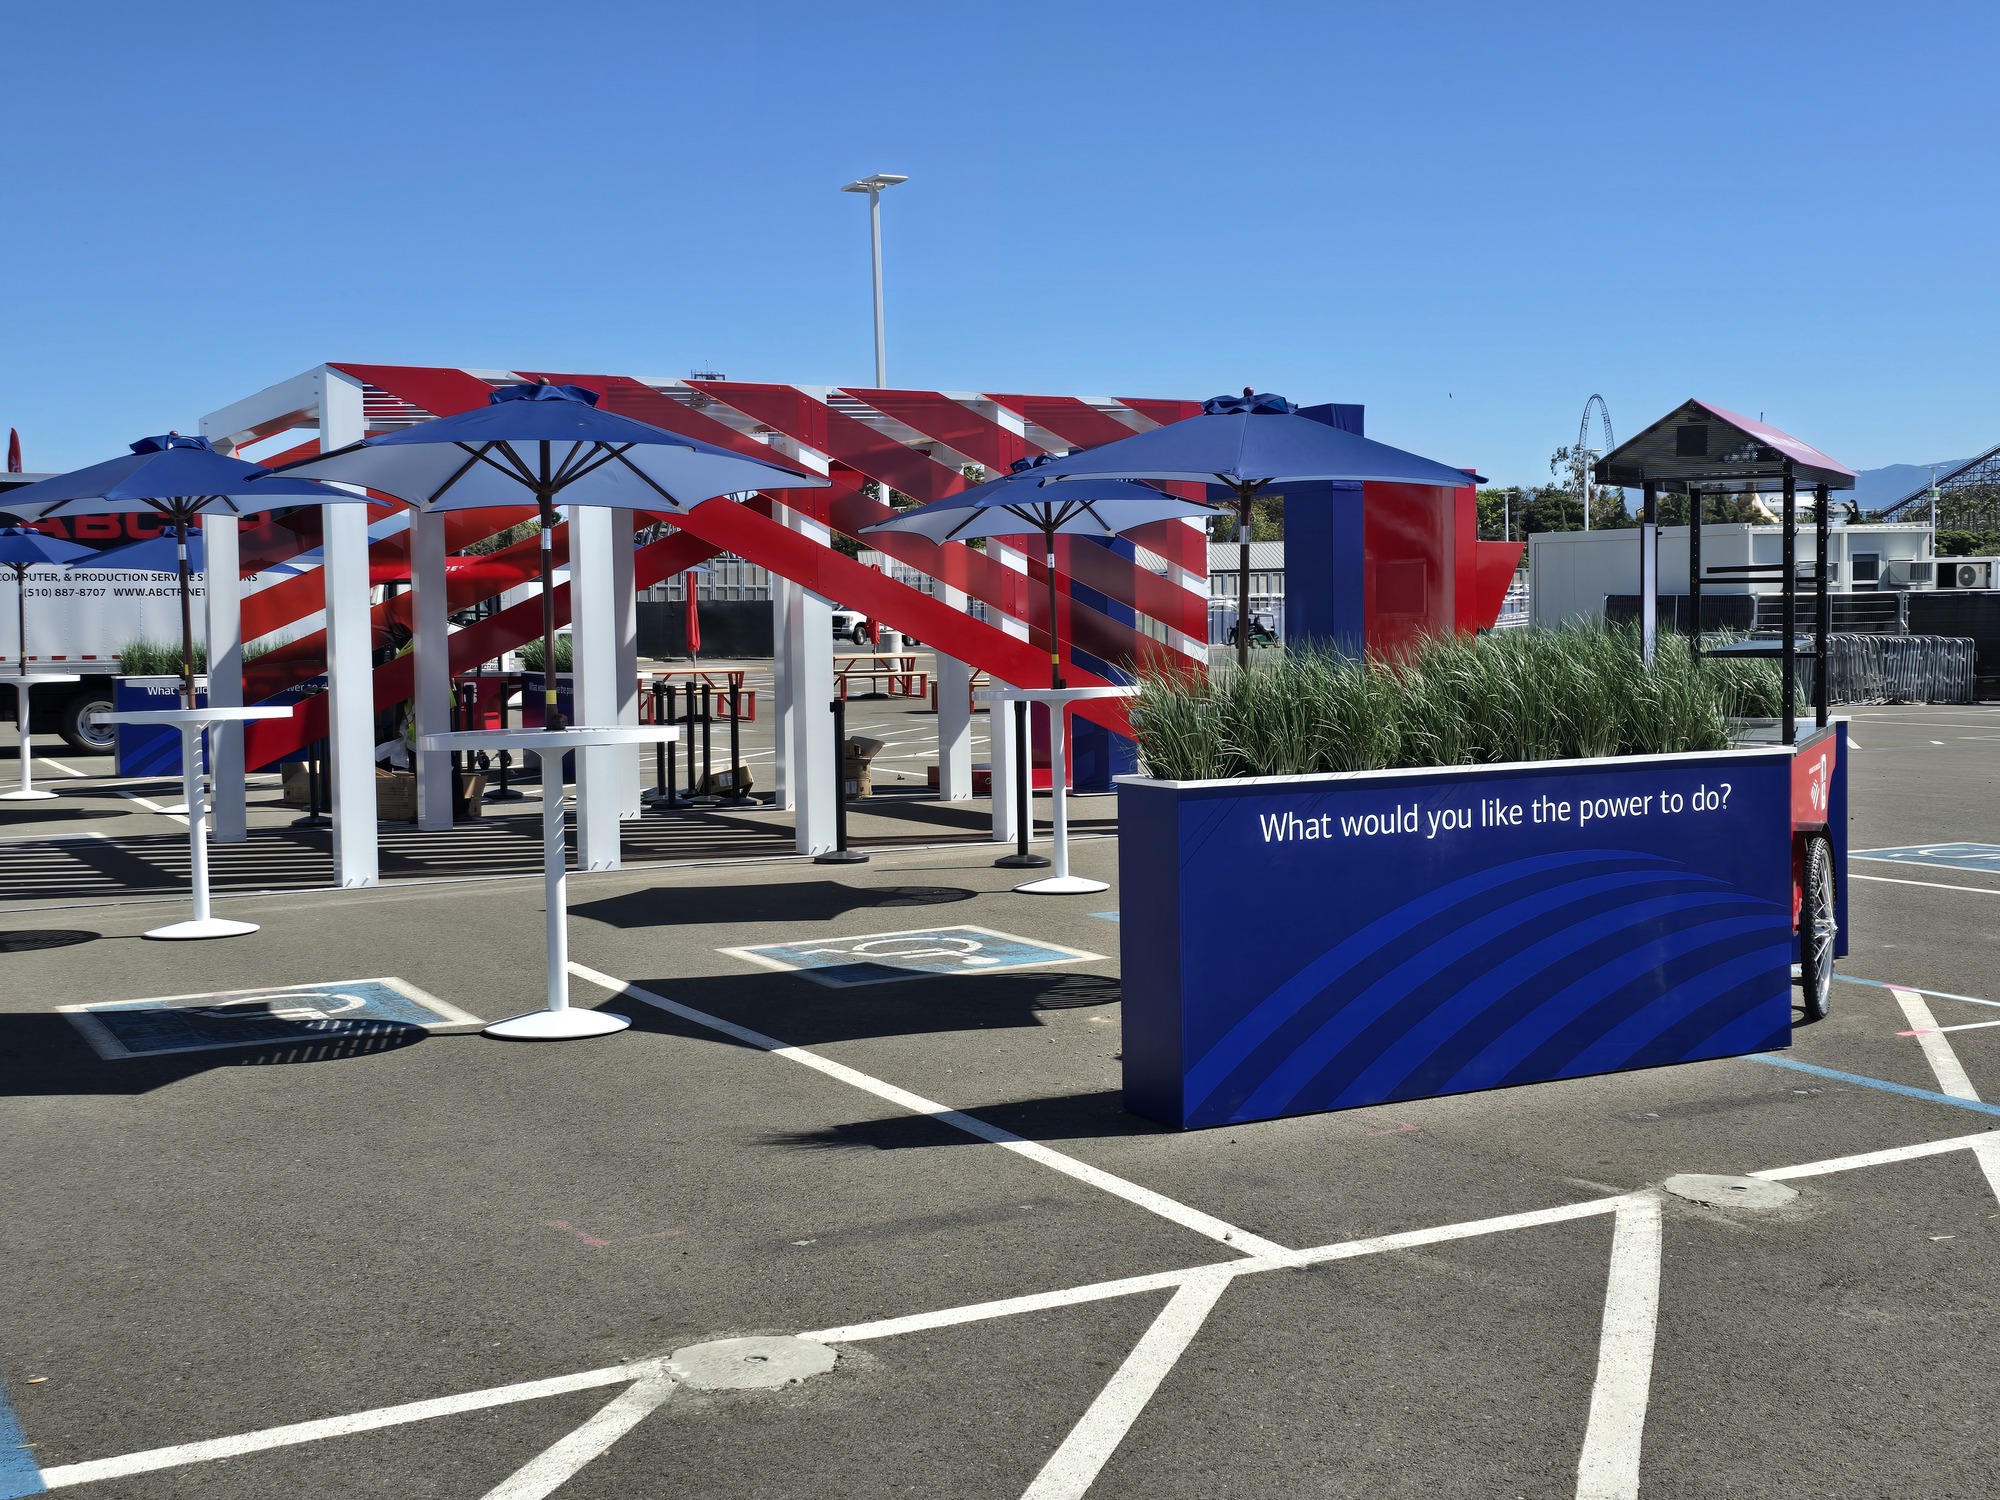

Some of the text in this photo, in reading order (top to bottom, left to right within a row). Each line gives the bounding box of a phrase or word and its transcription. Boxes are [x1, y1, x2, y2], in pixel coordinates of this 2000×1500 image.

[63, 573, 72, 582] &
[74, 573, 149, 582] PRODUCTION
[24, 588, 52, 598] (510)
[54, 588, 106, 597] 887-8707
[147, 685, 176, 696] What
[1259, 783, 1732, 843] What would you like the power to do?
